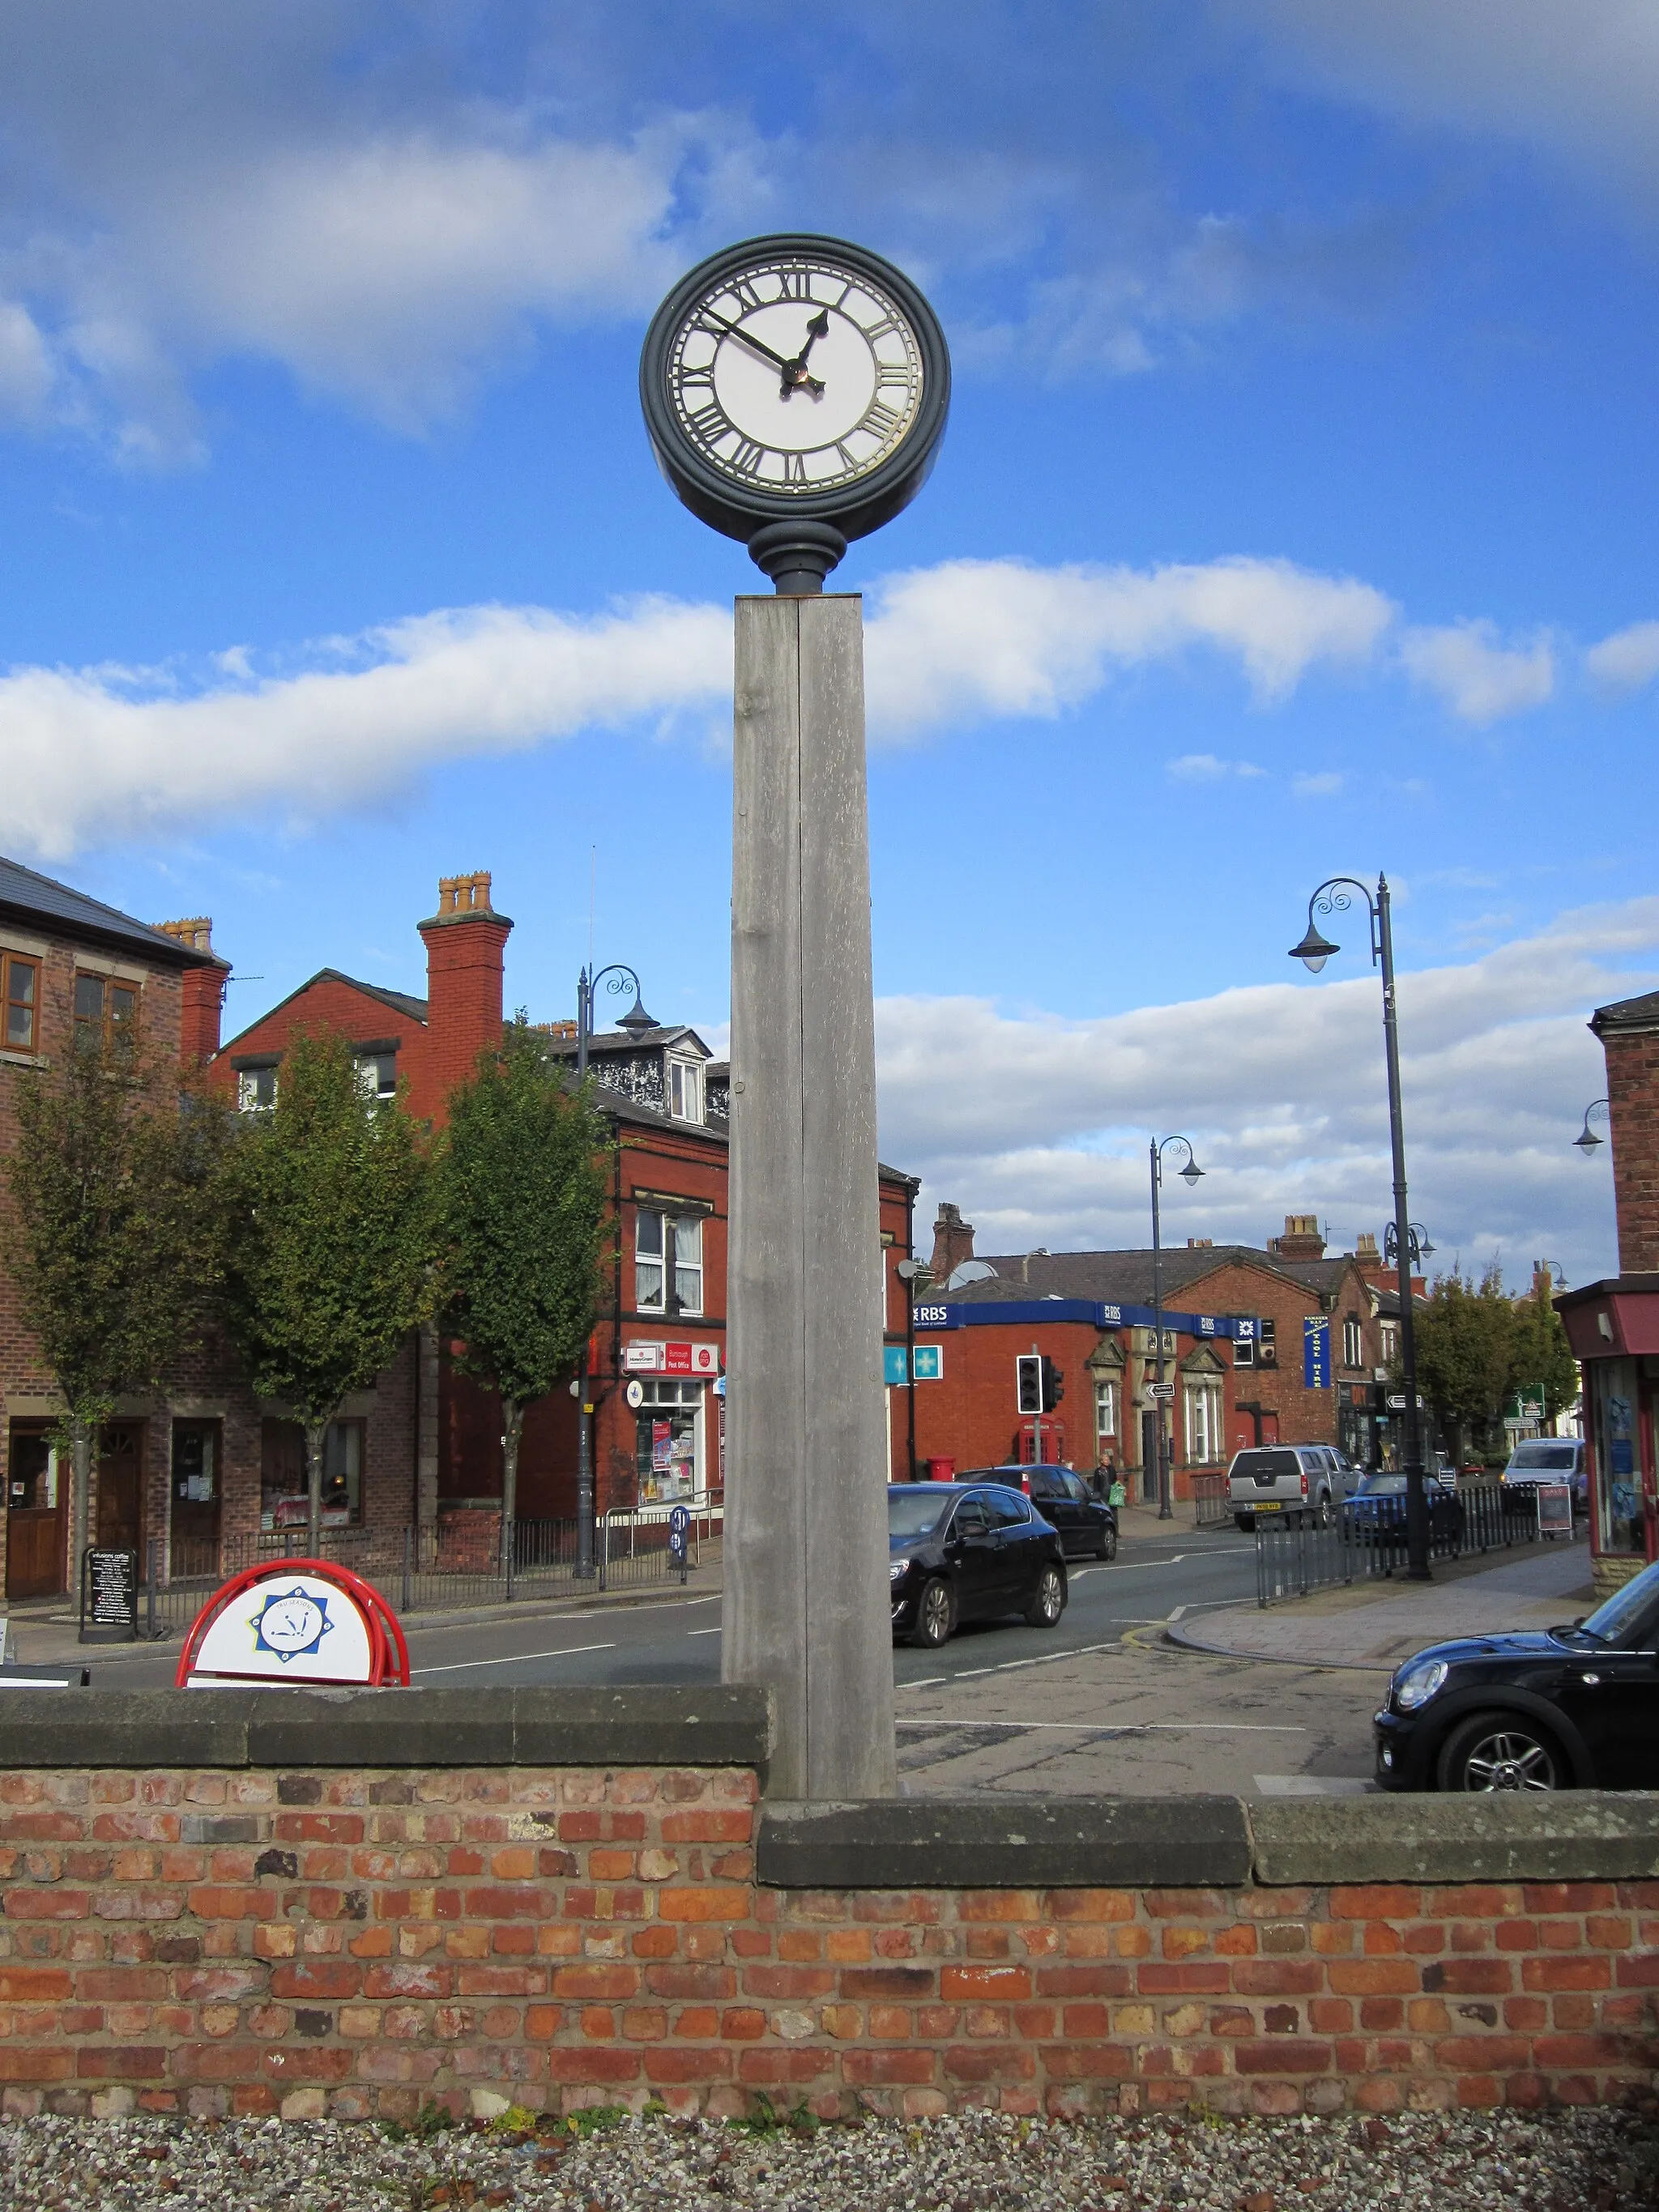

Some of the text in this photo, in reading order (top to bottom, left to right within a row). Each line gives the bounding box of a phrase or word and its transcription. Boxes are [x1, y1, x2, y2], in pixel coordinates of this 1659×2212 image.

[726, 280, 763, 317] XI
[778, 271, 812, 300] XII
[864, 313, 899, 341] II
[682, 363, 714, 390] IX
[877, 361, 911, 388] III
[688, 399, 731, 445] VIII
[729, 441, 765, 472] VII
[783, 452, 808, 482] VI
[835, 441, 859, 470] V
[920, 1306, 948, 1321] RBS
[1109, 1306, 1121, 1320] RBS
[1312, 1333, 1321, 1357] TOOL
[668, 1361, 689, 1370] Post Office
[1312, 1364, 1322, 1387] HIRE
[275, 1600, 314, 1611] TRU SEASONS
